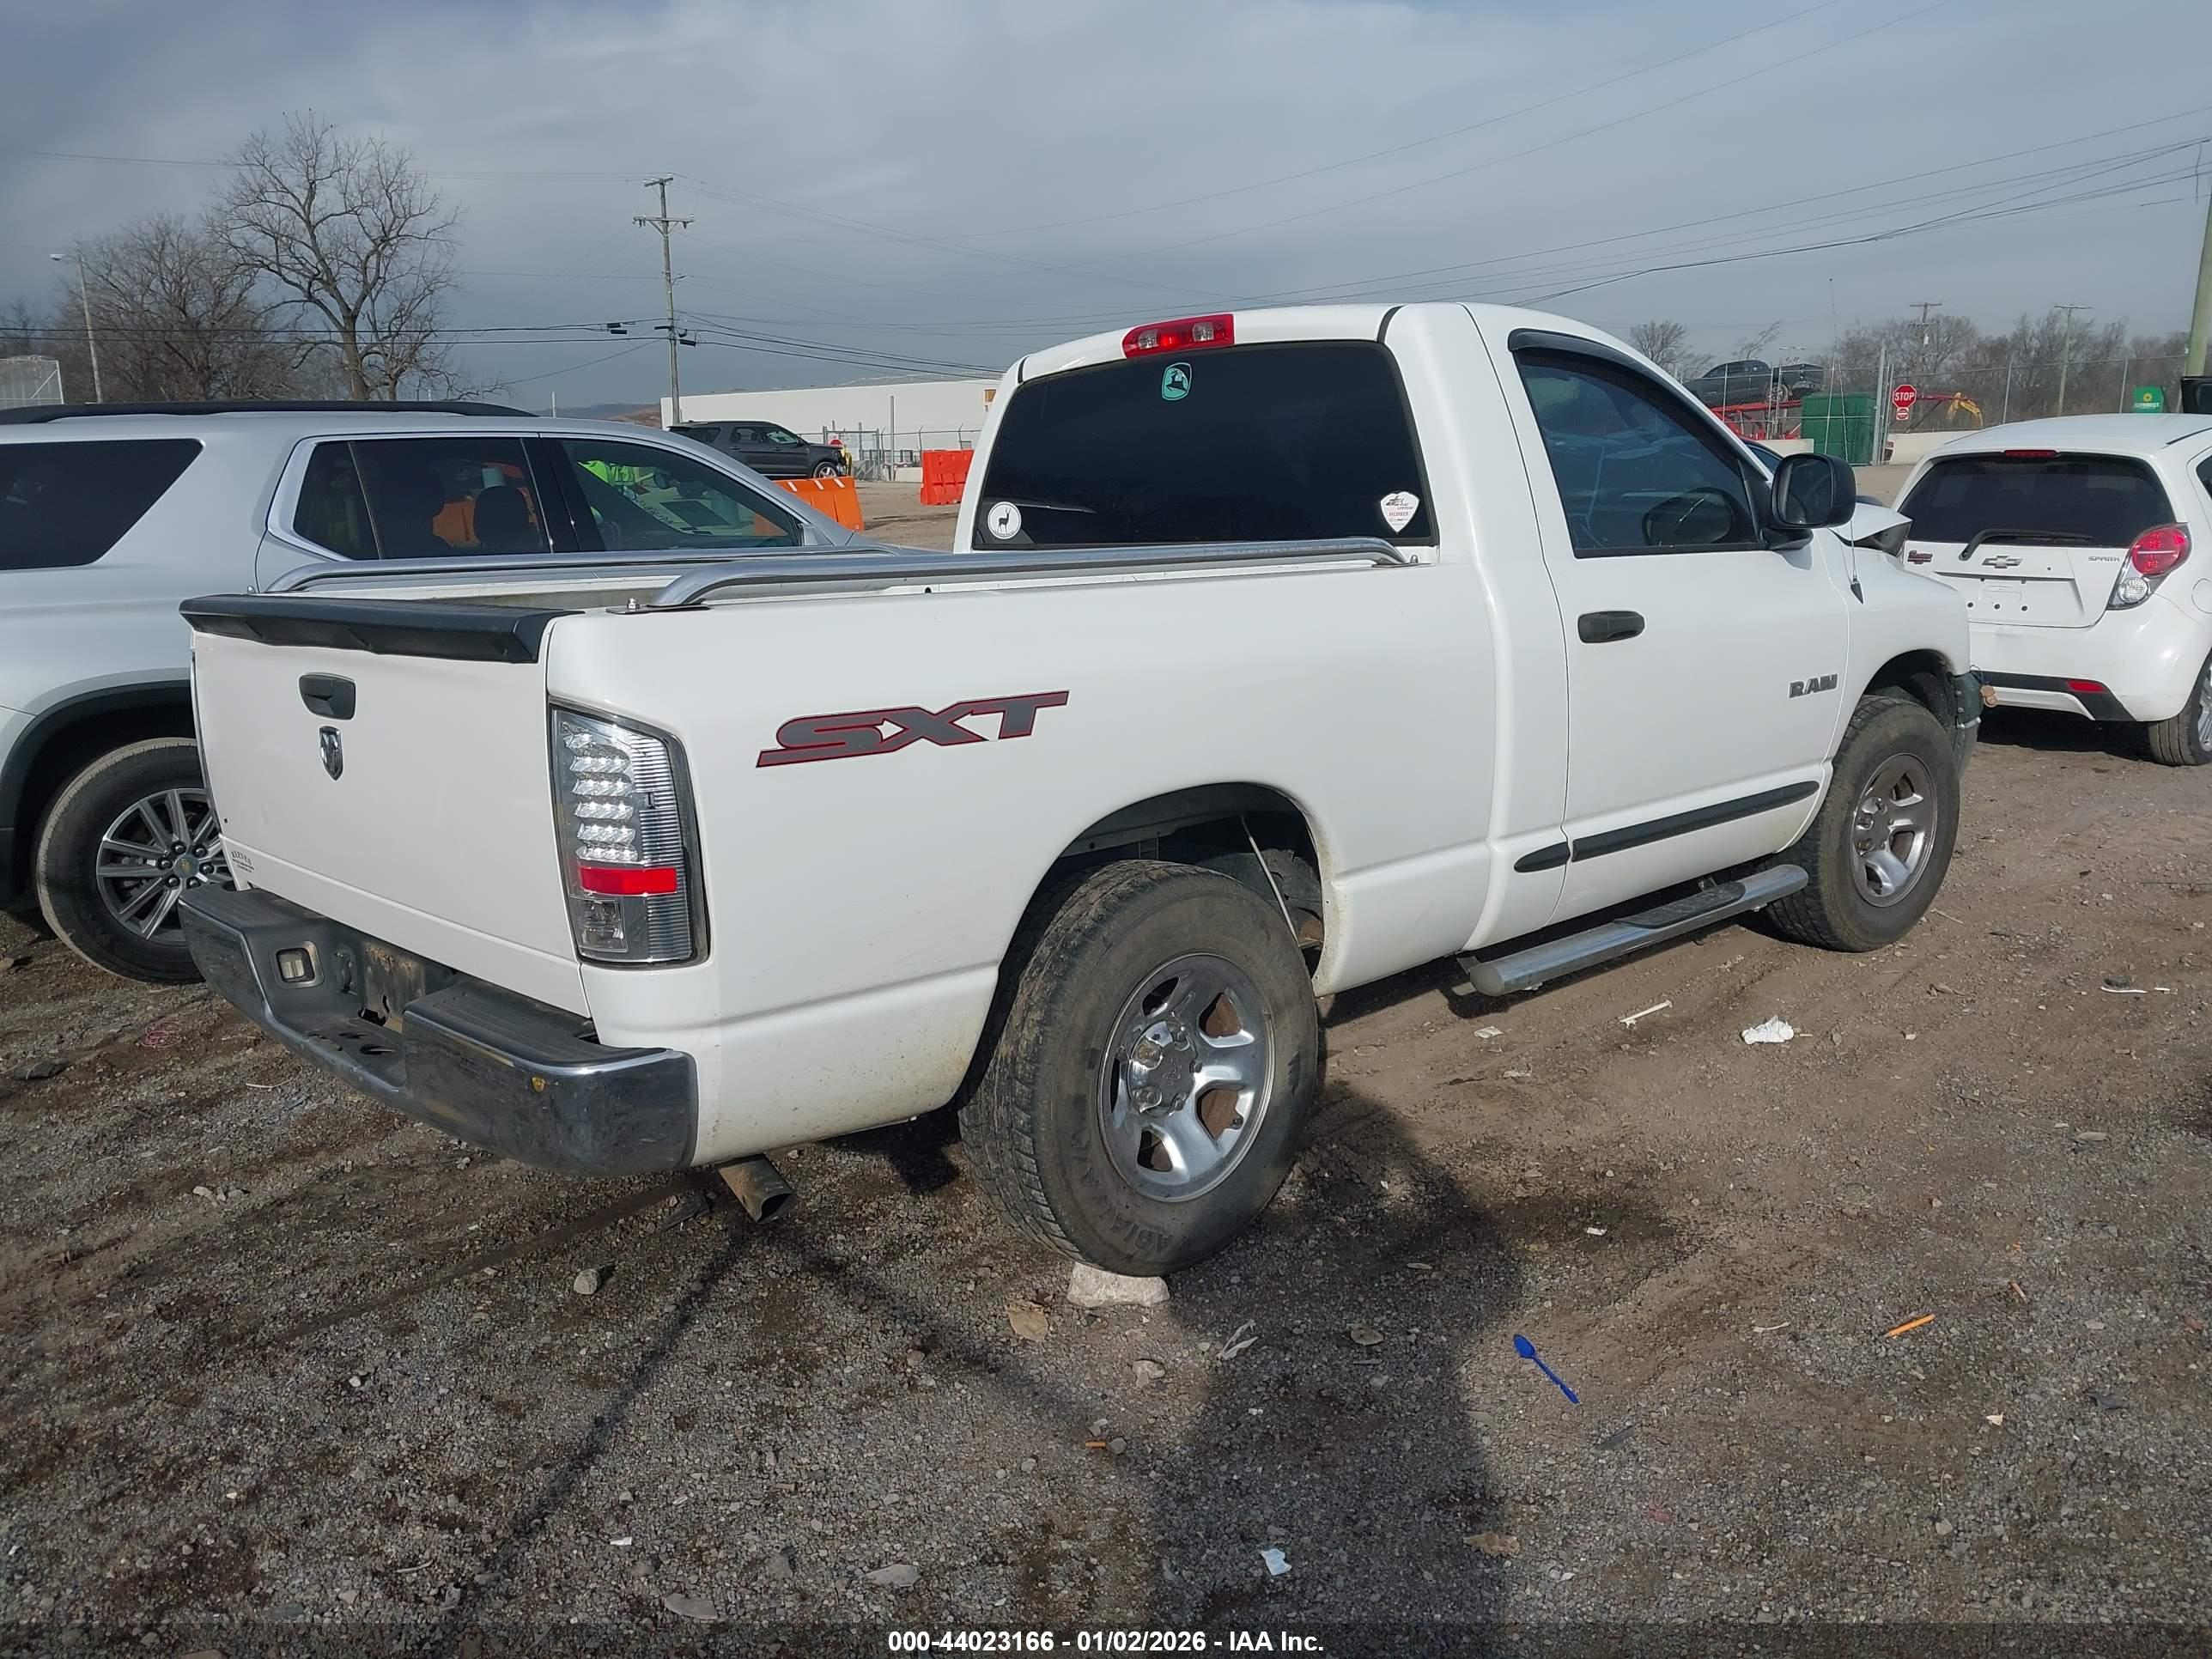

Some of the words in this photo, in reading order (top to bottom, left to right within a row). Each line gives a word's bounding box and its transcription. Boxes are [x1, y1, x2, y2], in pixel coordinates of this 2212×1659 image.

[1894, 392, 1915, 401] STOP
[1789, 673, 1838, 699] RAM
[756, 690, 1070, 769] SXT
